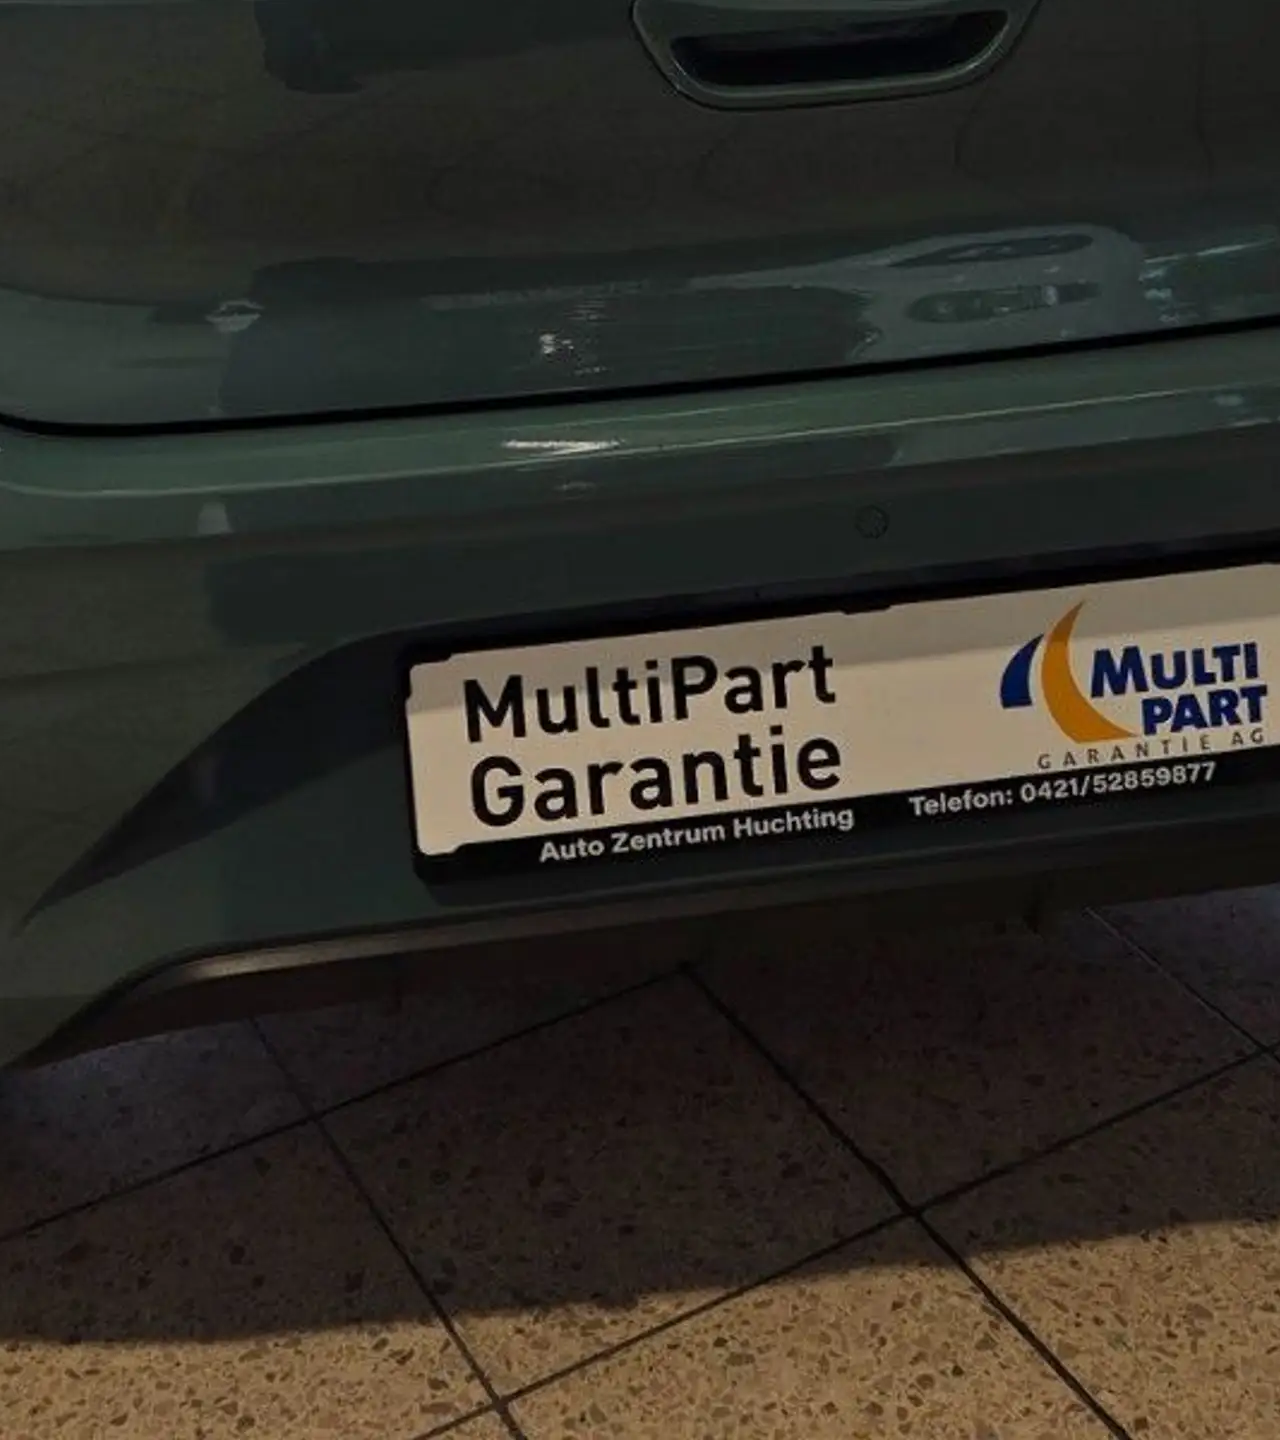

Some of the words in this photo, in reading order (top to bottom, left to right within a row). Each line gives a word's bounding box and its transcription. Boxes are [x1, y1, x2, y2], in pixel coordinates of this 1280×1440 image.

[463, 645, 837, 744] MultiPart
[1090, 641, 1258, 699] MULTI
[1141, 684, 1268, 736] PART
[471, 724, 841, 828] Garantie
[1037, 733, 1210, 770] GARANTIE
[1230, 728, 1265, 746] AG
[909, 787, 1013, 817] Telefon:
[1020, 760, 1218, 803] 0421/52859877
[539, 838, 605, 862] Auto
[611, 822, 726, 854] Zentrum
[733, 806, 854, 839] Huchting
